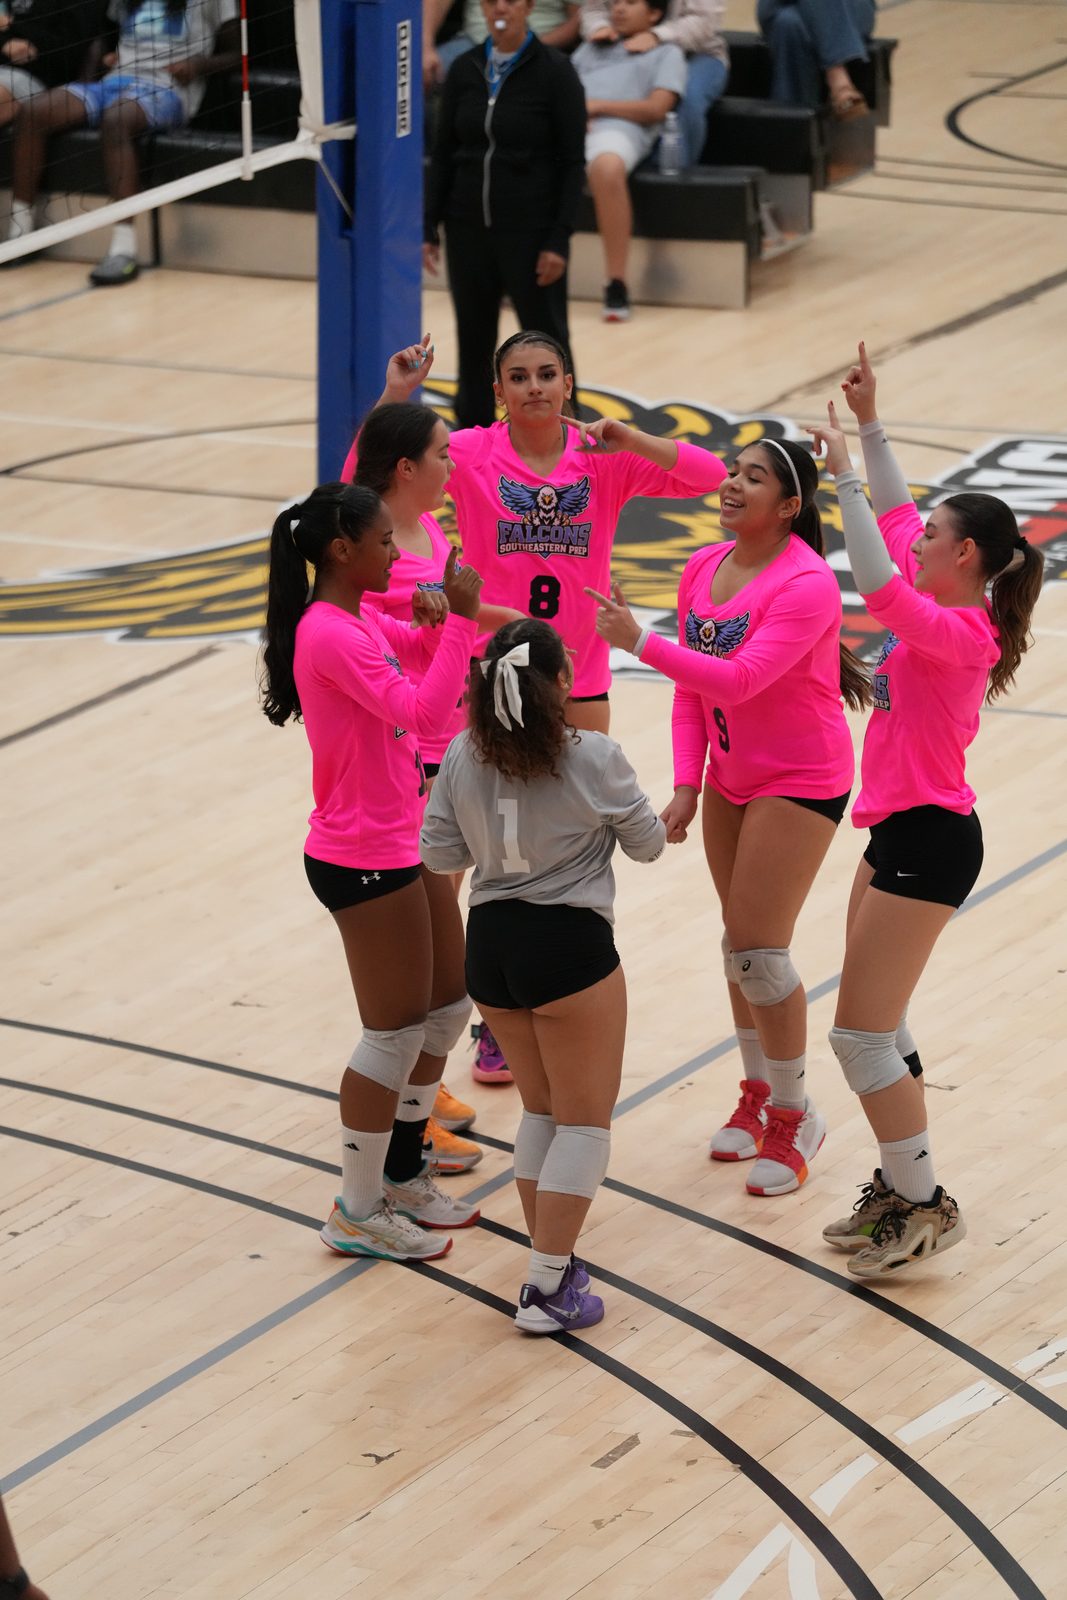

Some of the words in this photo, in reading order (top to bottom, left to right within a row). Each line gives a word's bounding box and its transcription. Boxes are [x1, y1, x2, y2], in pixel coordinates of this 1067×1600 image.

[499, 522, 591, 545] FALCONS
[500, 543, 566, 553] SOUTHEASTERN
[568, 545, 587, 555] PREP
[528, 575, 561, 619] 8
[874, 699, 889, 710] REP
[713, 706, 731, 754] 9
[497, 798, 531, 874] 1
